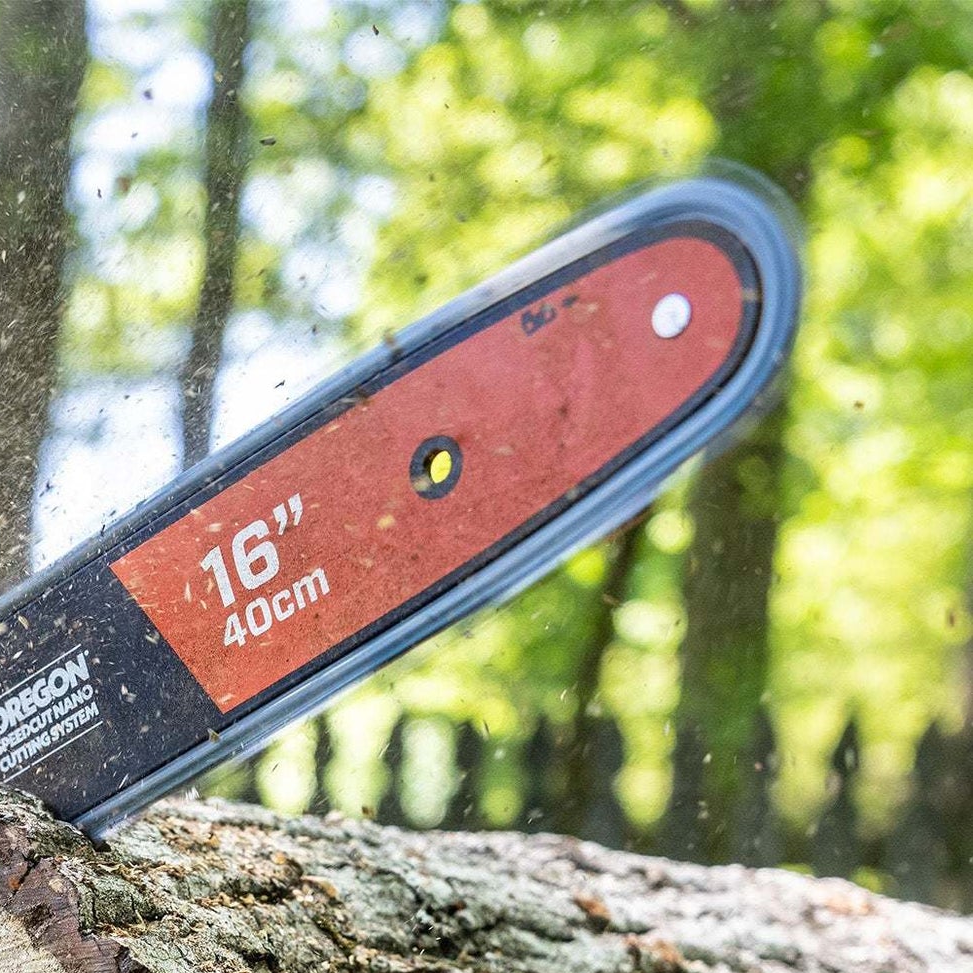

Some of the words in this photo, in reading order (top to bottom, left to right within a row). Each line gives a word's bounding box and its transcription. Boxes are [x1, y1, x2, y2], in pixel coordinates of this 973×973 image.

[221, 567, 330, 648] 40cm
[0, 730, 52, 773] CUTTING
[50, 701, 100, 741] SYSTEM
[52, 684, 94, 720] NANO
